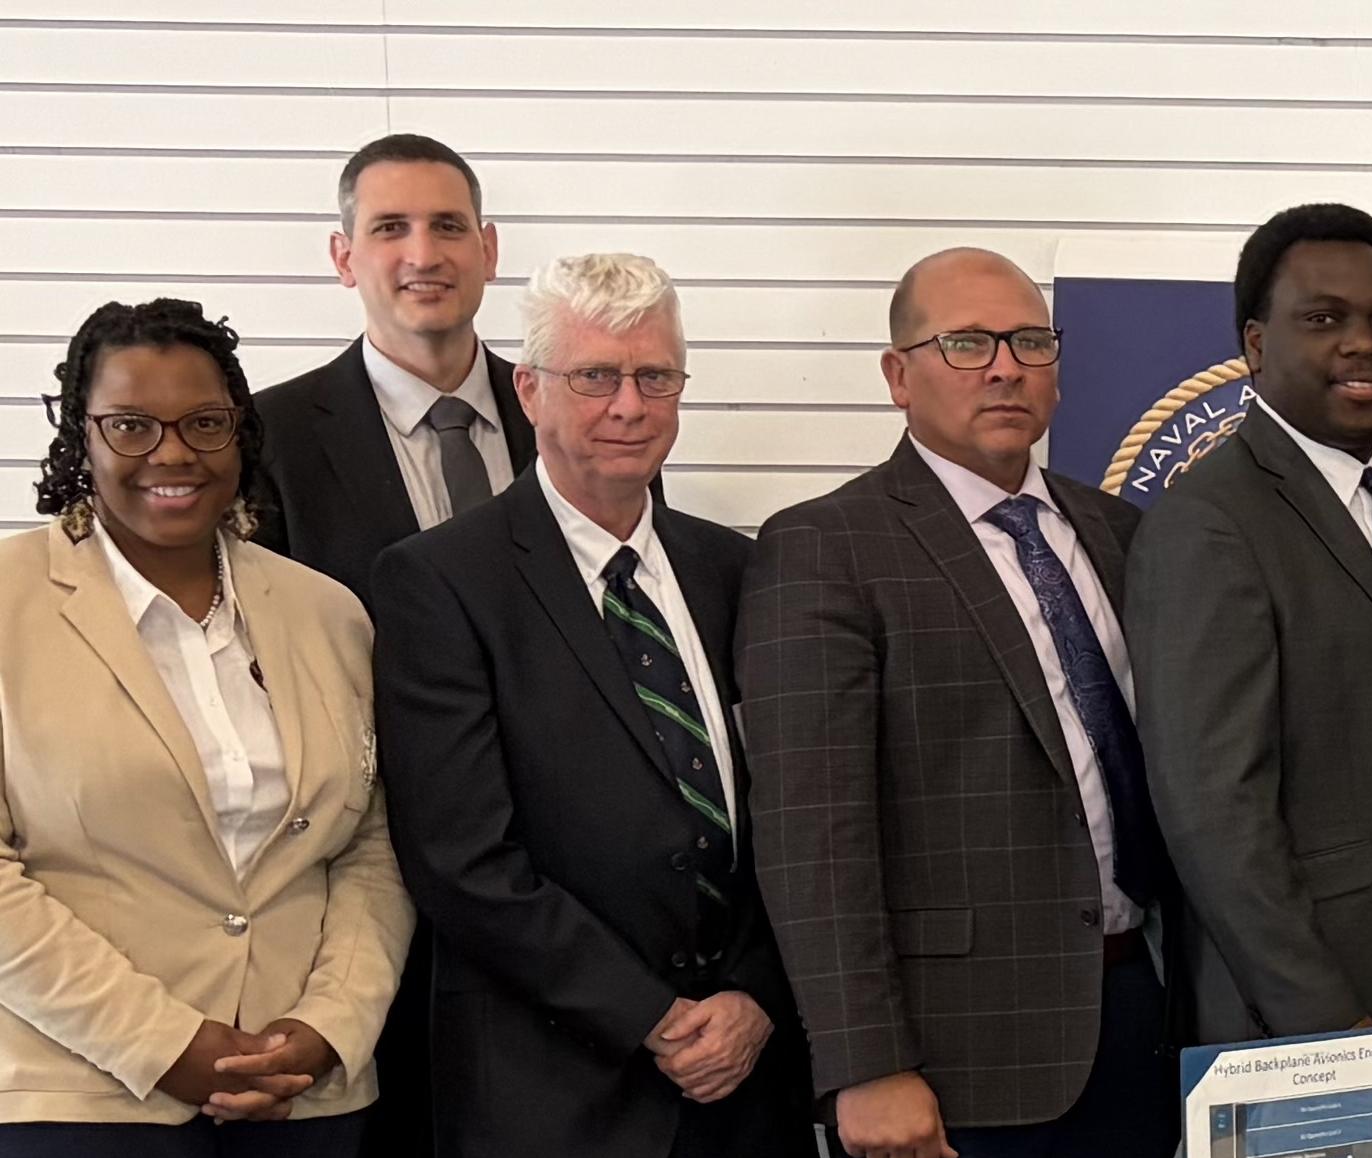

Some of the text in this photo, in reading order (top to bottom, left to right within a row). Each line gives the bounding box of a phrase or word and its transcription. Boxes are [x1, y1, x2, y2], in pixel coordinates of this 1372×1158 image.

[1132, 401, 1226, 493] NAVAL
[1214, 1061, 1251, 1077] Hybrid
[1254, 1056, 1311, 1073] Backplane
[1313, 1049, 1357, 1065] Avionics
[1292, 1070, 1336, 1086] Concept
